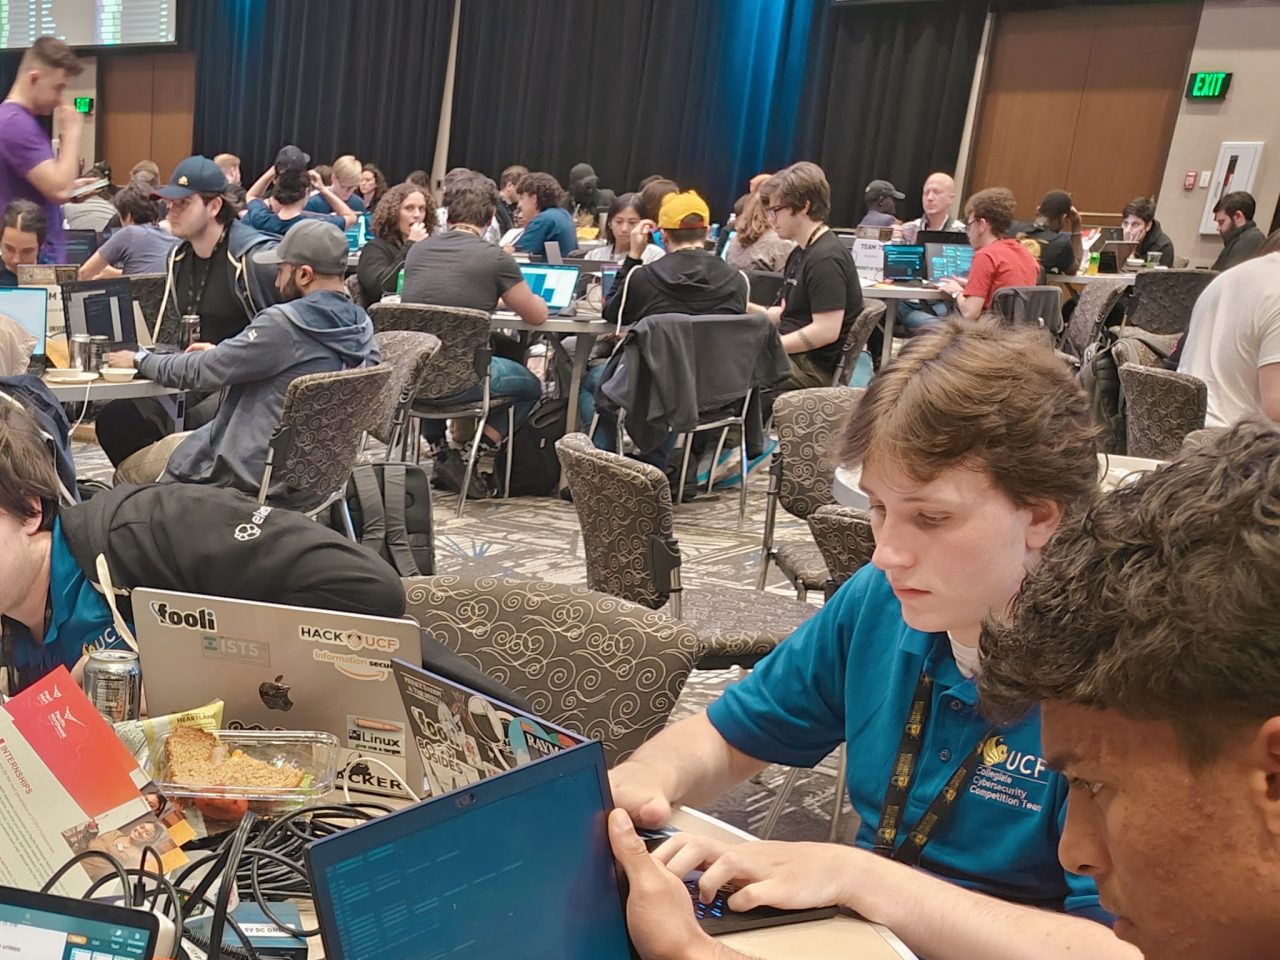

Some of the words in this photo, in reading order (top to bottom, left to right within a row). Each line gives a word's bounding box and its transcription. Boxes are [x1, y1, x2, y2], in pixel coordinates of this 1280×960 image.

[1193, 72, 1226, 96] EXIT
[155, 603, 216, 631] fooli
[301, 626, 344, 643] HACK
[365, 636, 397, 649] UCF
[314, 651, 368, 666] information
[363, 731, 401, 748] Linux
[0, 745, 33, 795] INTERNSHIPS
[976, 766, 1013, 784] Collegiate
[1006, 750, 1048, 778] UCF
[337, 767, 403, 791] ACKER
[973, 776, 1028, 798] Cybersecurity
[970, 785, 1020, 807] Competition
